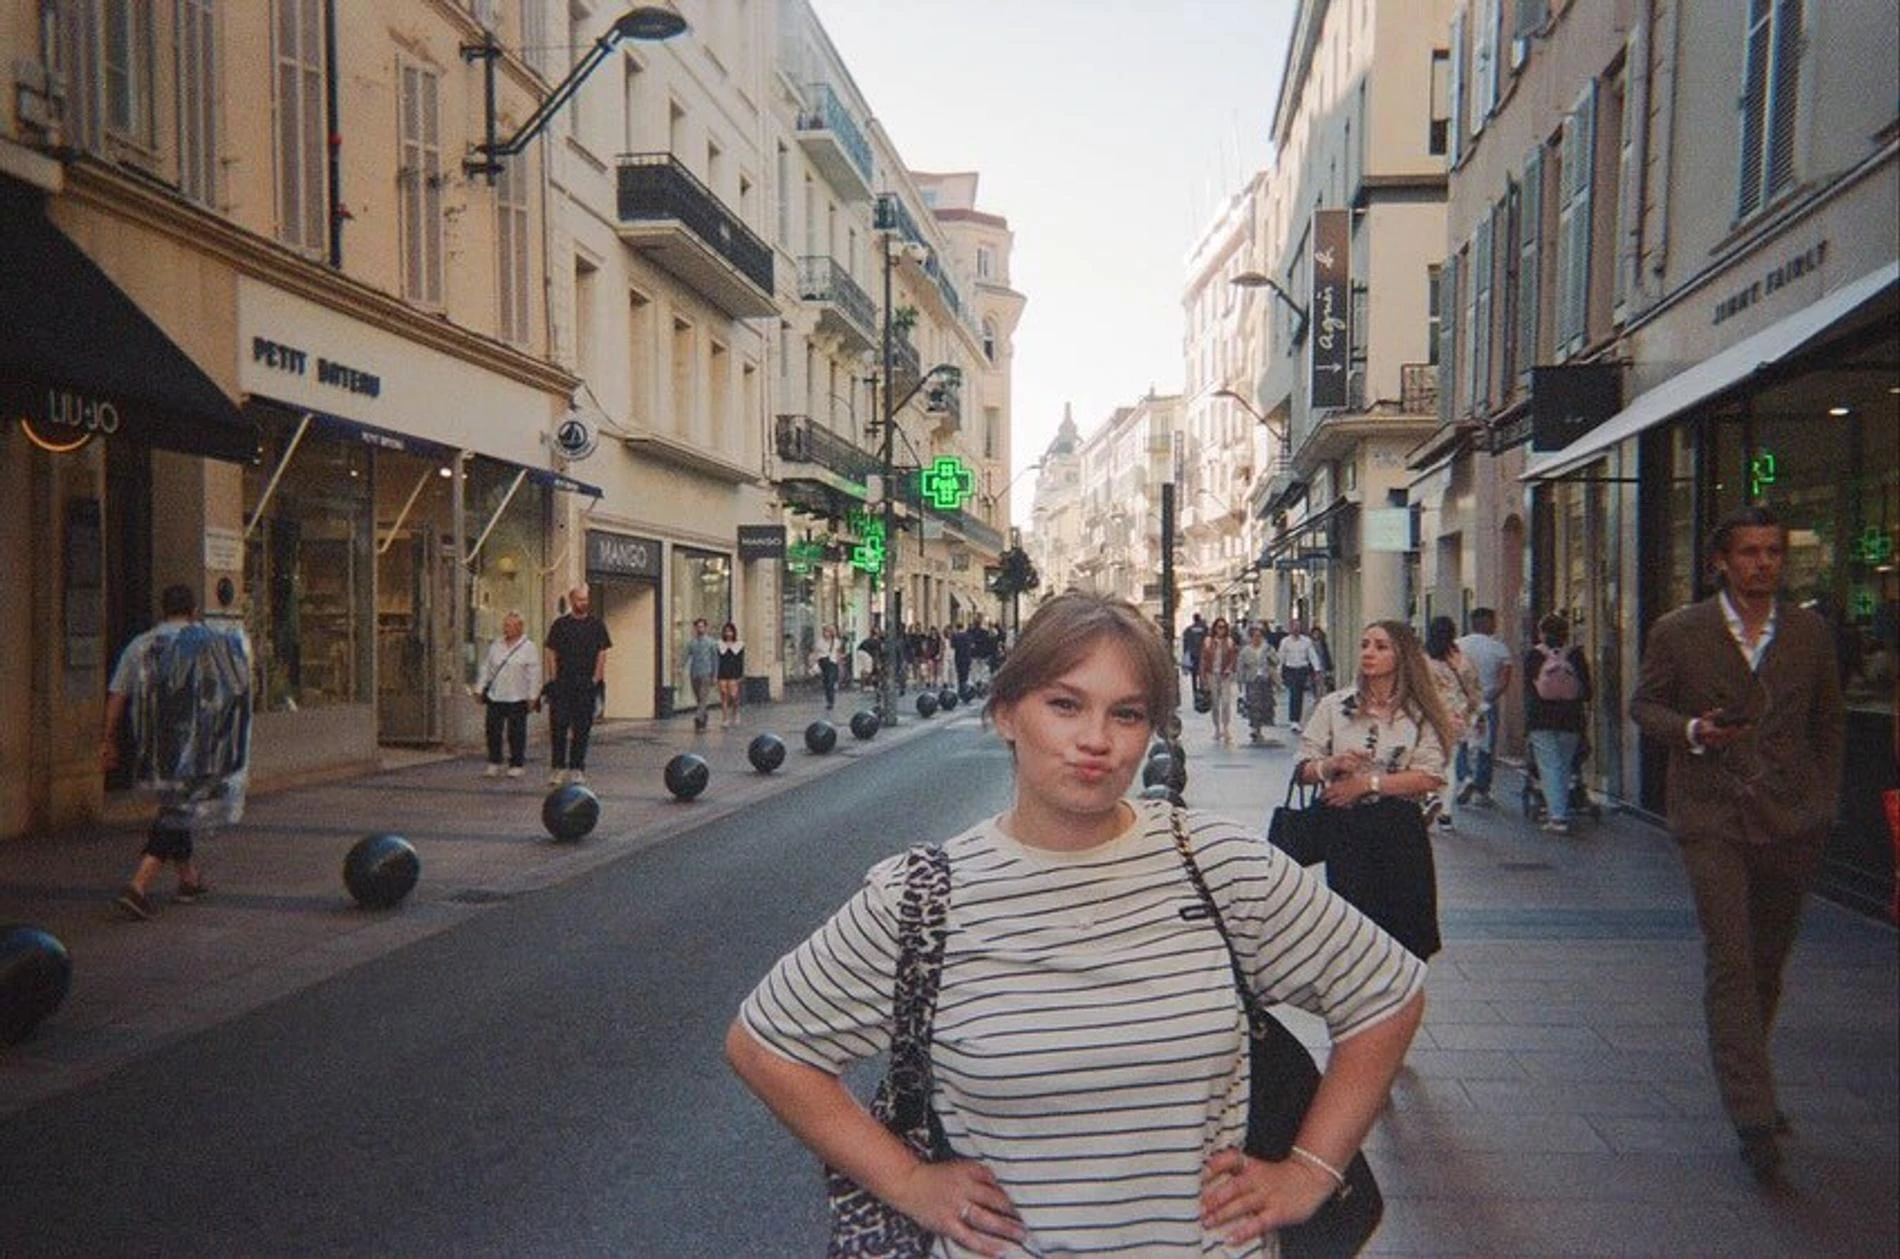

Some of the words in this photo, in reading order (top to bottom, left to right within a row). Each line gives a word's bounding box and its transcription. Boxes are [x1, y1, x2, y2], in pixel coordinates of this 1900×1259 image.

[252, 335, 308, 376] PETIT
[600, 539, 647, 569] MANGO
[742, 537, 783, 546] MANGO
